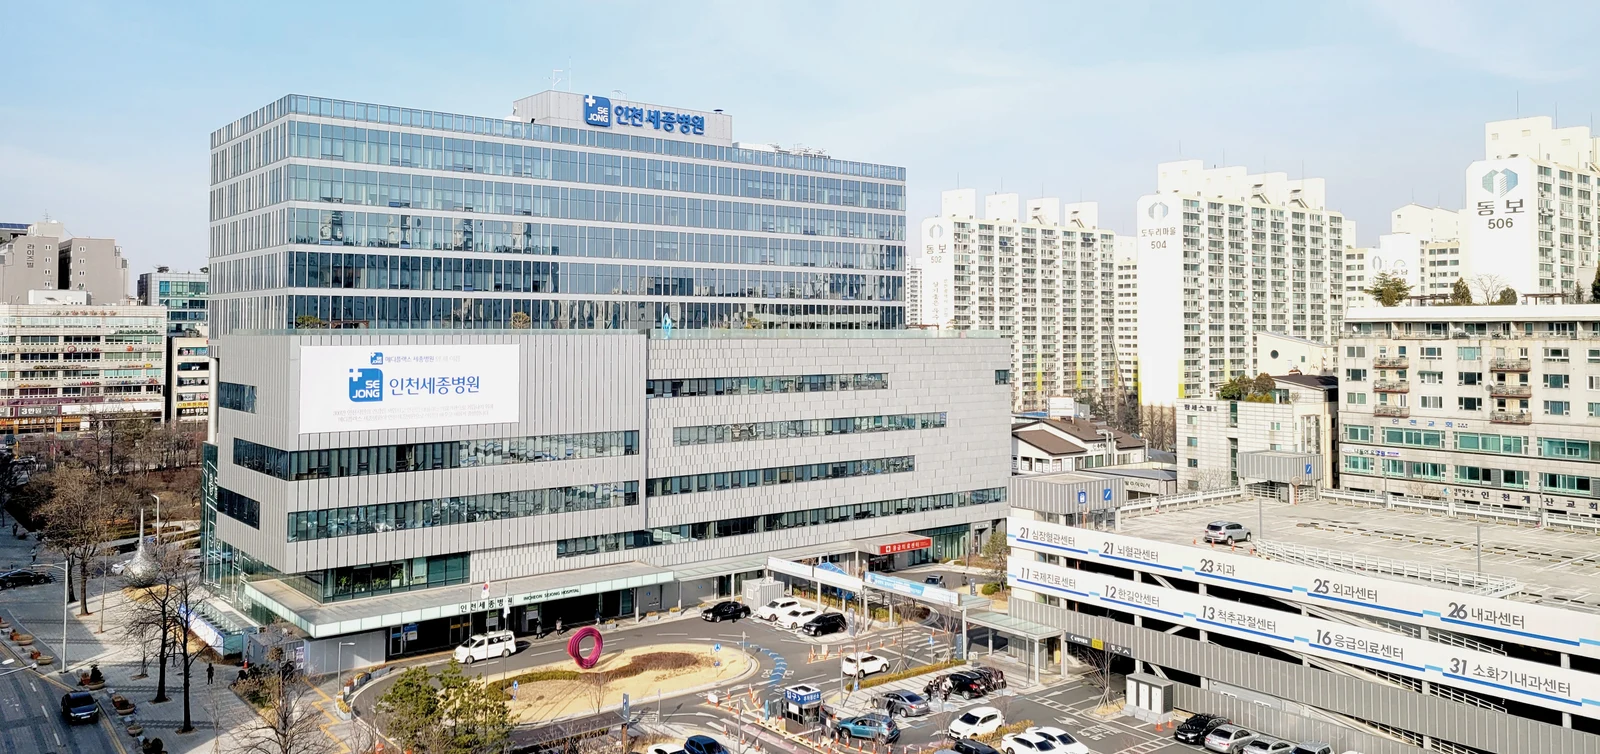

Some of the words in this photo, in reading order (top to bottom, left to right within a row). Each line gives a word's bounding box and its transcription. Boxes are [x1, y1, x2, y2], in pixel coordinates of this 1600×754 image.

[597, 106, 609, 115] SE
[588, 113, 609, 123] JONG
[1488, 217, 1513, 230] 506
[1141, 227, 1176, 237] 도두리마을
[1151, 240, 1167, 250] 504
[930, 256, 942, 264] 502
[365, 380, 380, 389] SE
[389, 375, 480, 396] 인천세종병원
[352, 389, 380, 399] JONG
[21, 407, 42, 415] 3만원
[1019, 527, 1029, 539] 21
[1031, 529, 1076, 548] 심장혈관센터
[1103, 541, 1114, 555] 21
[1117, 544, 1159, 563] 뇌혈관센터
[1200, 558, 1214, 573] 23
[1216, 562, 1236, 577] 치과
[1313, 578, 1330, 594] 25
[1332, 583, 1378, 603] 외과센터
[1447, 601, 1468, 620] 26
[1471, 607, 1525, 630] 내과센터
[460, 596, 513, 613] 인천세종병원
[1021, 567, 1030, 580] 11
[1032, 570, 1076, 589] 국제진료센터
[1105, 584, 1117, 598] 12
[1118, 588, 1160, 607] 한길안센터
[1202, 605, 1216, 620] 13
[1217, 610, 1276, 633] 척추관절센터
[1316, 629, 1332, 645] 16
[1334, 634, 1404, 661] 응급의료센터
[1449, 657, 1468, 675] 31
[1472, 664, 1571, 697] 소화기내과센터
[786, 690, 797, 700] 입구
